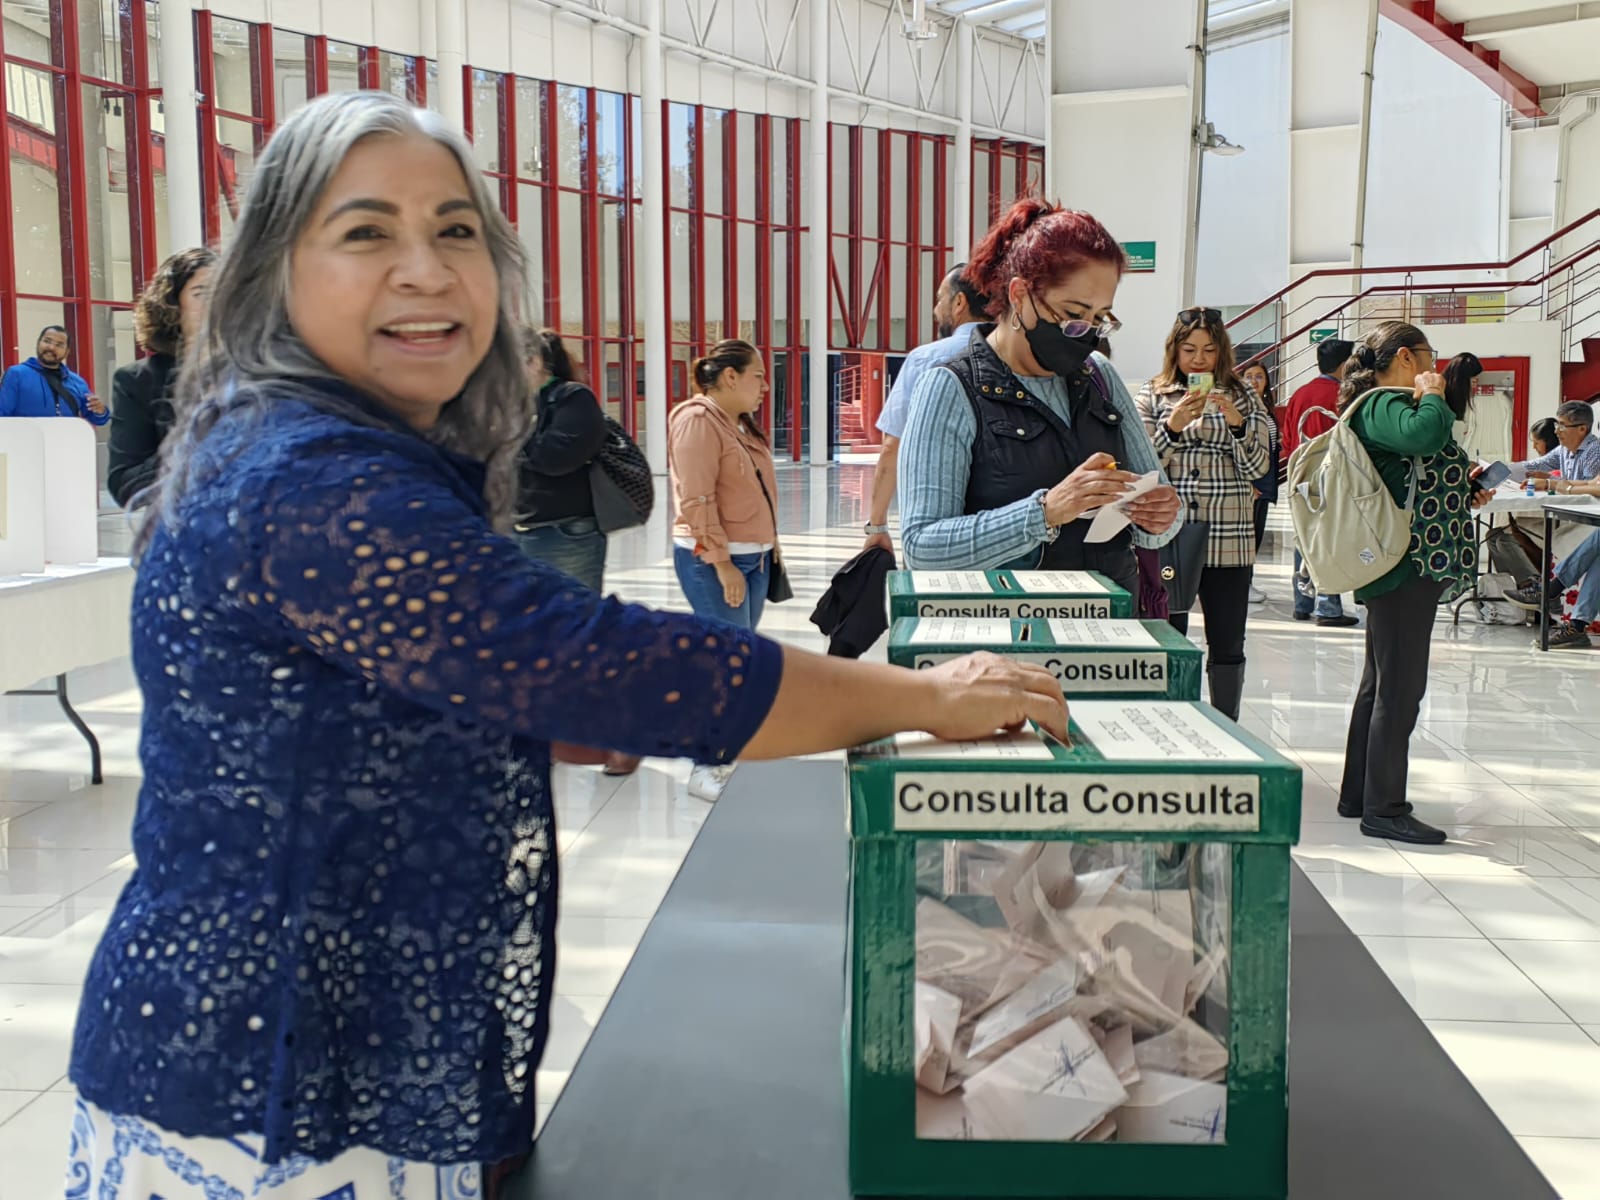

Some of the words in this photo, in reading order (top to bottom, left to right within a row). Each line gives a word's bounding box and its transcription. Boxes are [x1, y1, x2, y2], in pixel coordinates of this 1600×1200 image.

[919, 603, 1011, 618] Consulta
[1016, 602, 1109, 619] Consulta
[1044, 657, 1164, 681] Consulta
[899, 782, 1069, 814] Consulta
[1082, 783, 1255, 815] Consulta
